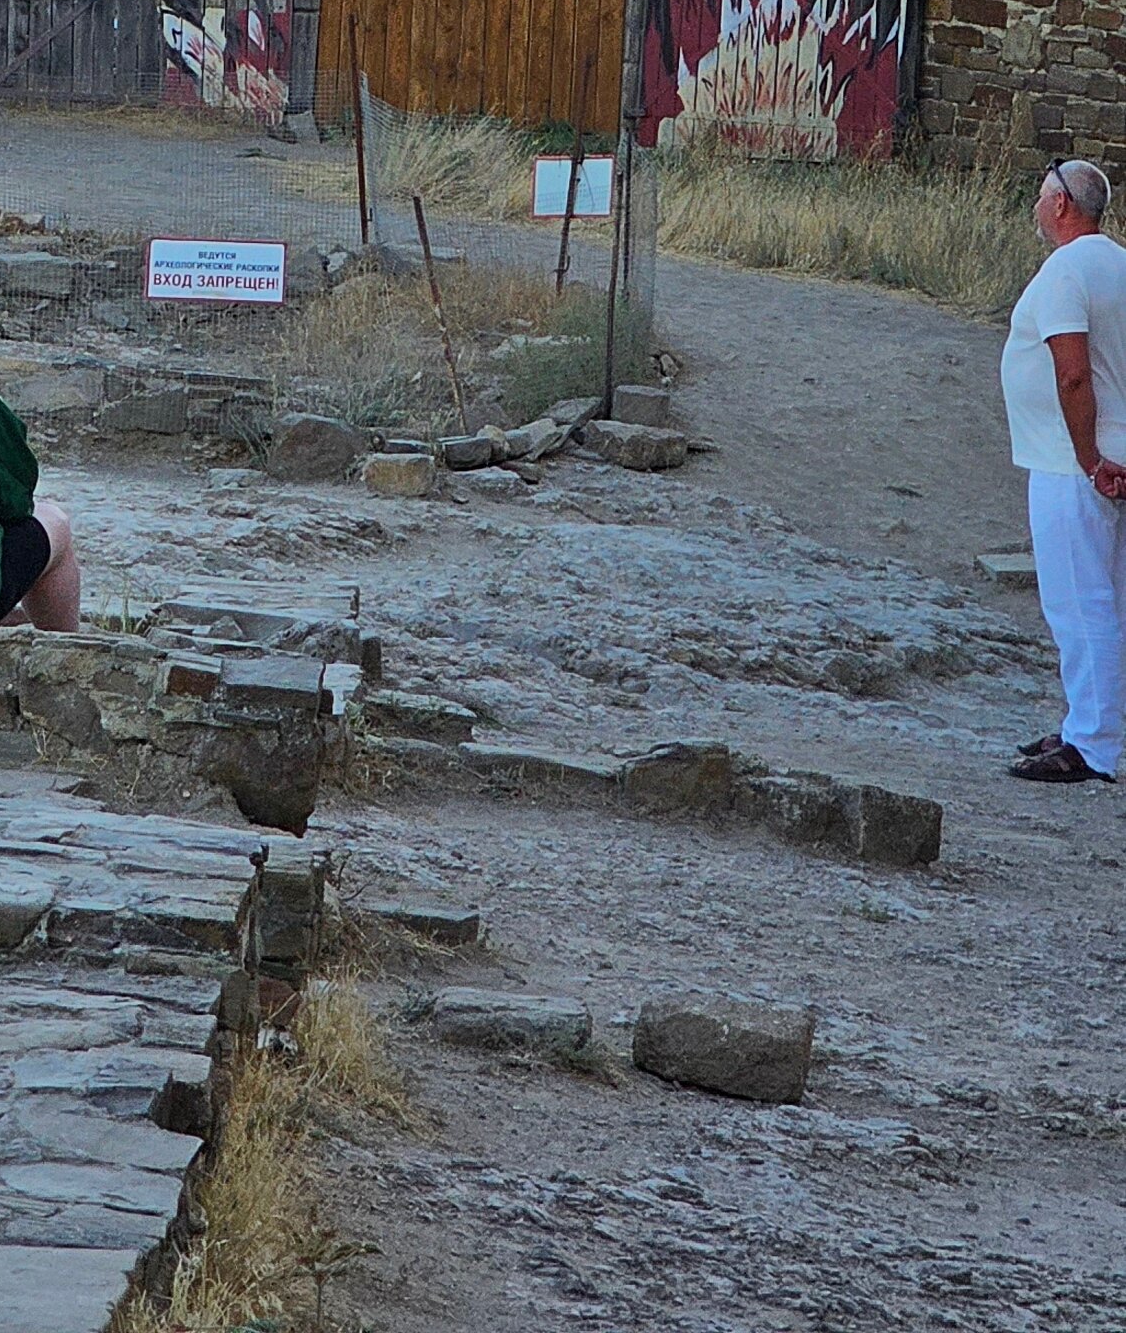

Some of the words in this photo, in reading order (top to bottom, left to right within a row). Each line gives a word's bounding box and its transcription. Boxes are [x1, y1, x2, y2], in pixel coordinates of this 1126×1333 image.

[198, 251, 237, 260] ВЕДУТСЯ
[154, 260, 233, 271] АРХЕОЛОГИЧЕСКИЕ
[236, 263, 280, 273] РАСКОПКИ
[154, 273, 192, 289] ВХОД
[196, 275, 279, 291] ЗАПРЕЩЕН!
